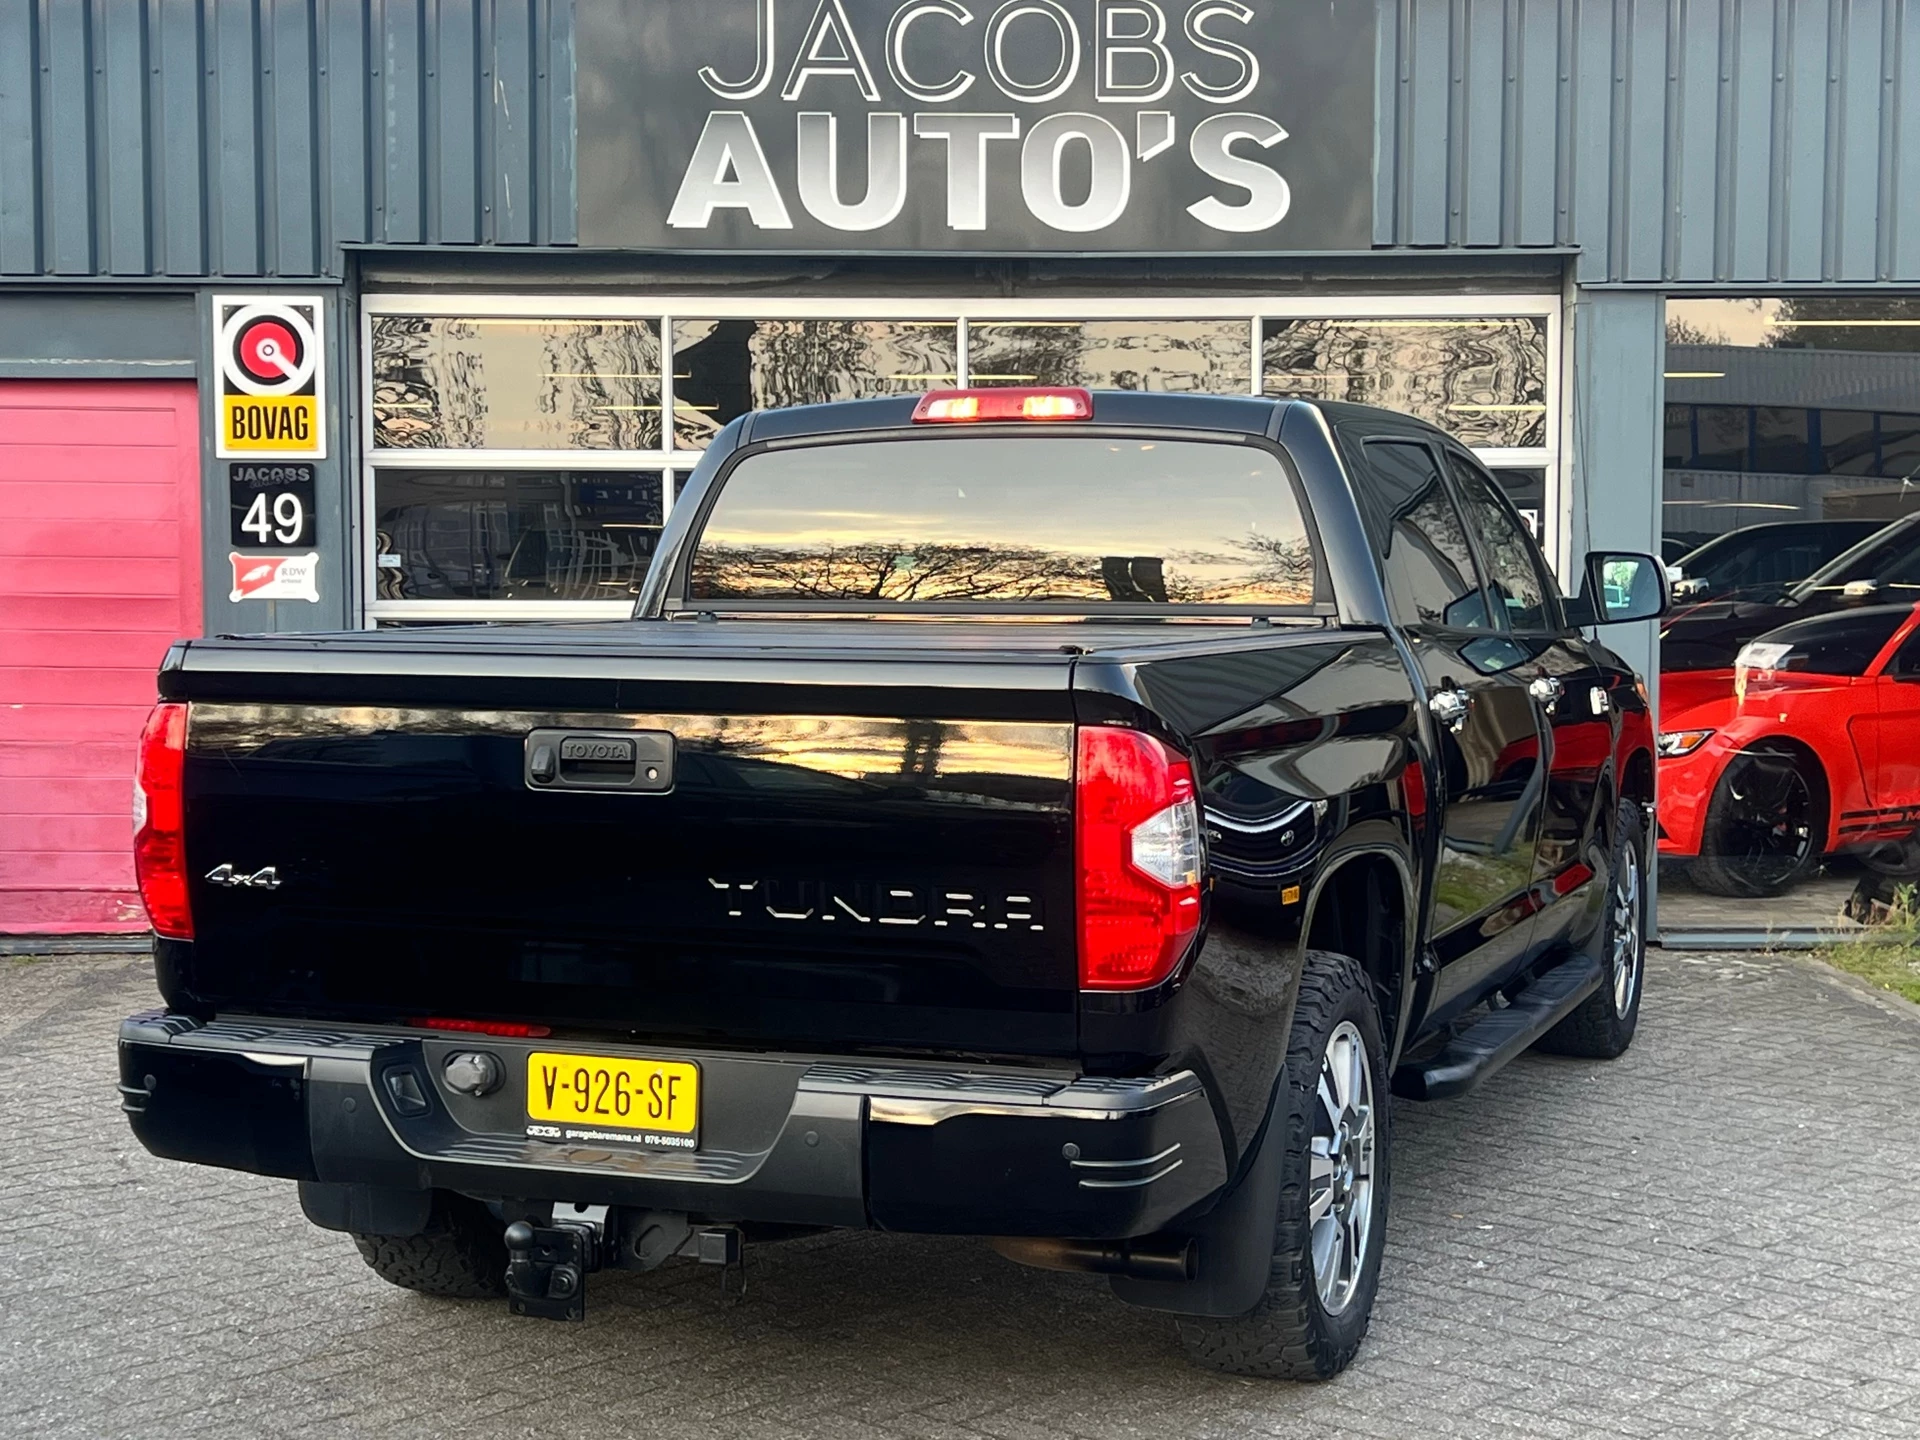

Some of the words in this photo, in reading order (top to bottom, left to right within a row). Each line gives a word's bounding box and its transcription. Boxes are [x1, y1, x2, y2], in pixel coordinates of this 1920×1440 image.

[698, 0, 1260, 103] JACOBS
[666, 111, 1291, 232] AUTO'S
[232, 405, 308, 440] BOVAG
[232, 467, 310, 482] JACOBS
[241, 492, 303, 544] 49
[565, 743, 628, 759] TOYOTA
[708, 877, 1044, 931] TUNDRA
[542, 1065, 681, 1120] V-926-SF
